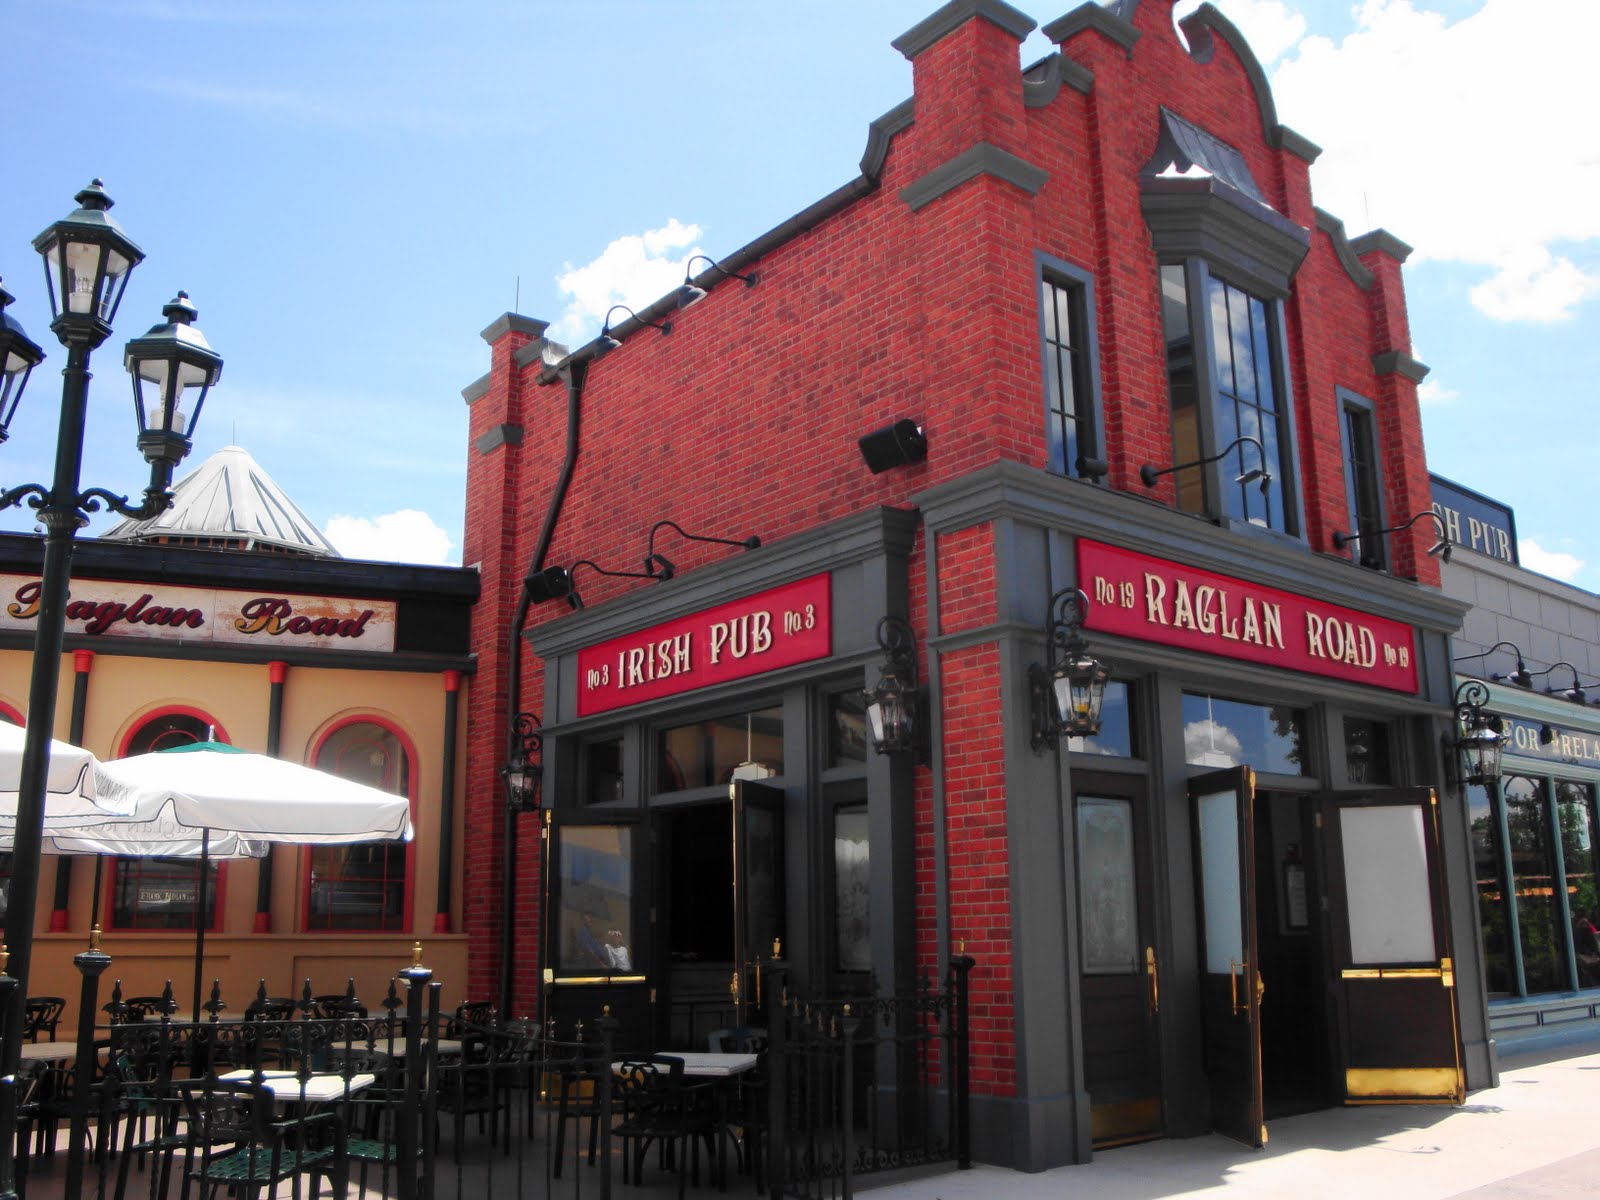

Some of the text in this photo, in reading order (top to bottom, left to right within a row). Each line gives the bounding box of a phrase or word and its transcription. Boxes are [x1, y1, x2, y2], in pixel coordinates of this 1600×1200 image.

[234, 597, 374, 638] Road
[602, 664, 609, 685] 3
[618, 631, 691, 689] IRISH
[709, 610, 772, 664] PUB
[805, 603, 814, 629] 3
[1119, 581, 1134, 608] 19
[1144, 572, 1285, 649] RAGLAN
[1305, 611, 1376, 668] ROAD
